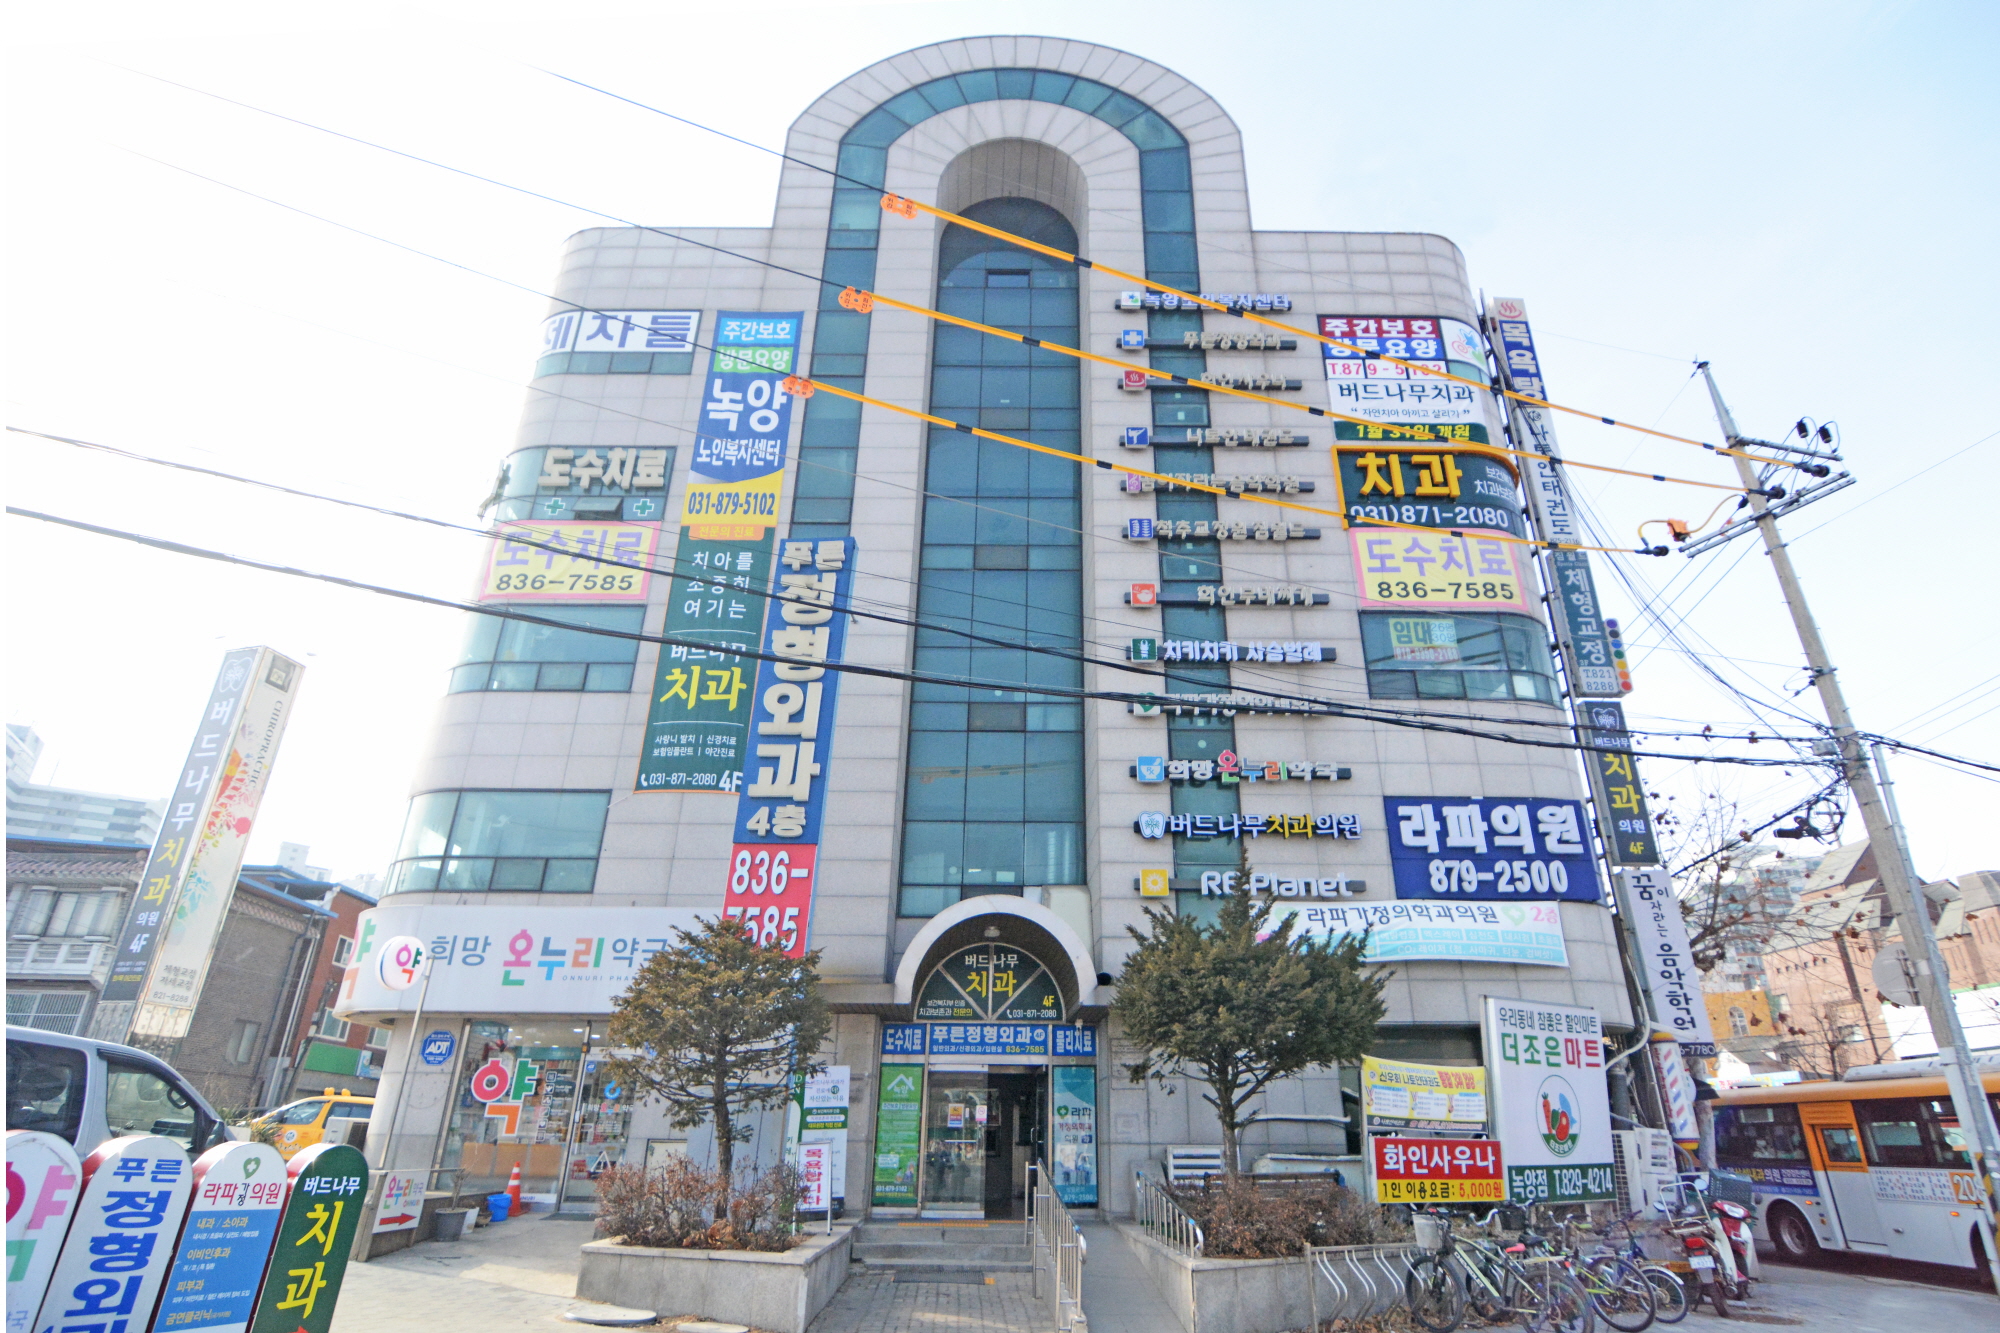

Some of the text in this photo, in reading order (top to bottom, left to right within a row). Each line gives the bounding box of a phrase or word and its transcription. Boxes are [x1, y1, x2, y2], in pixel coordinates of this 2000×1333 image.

[722, 320, 791, 342] 주간보호
[1324, 319, 1436, 339] 주간보호
[1328, 338, 1439, 357] 방문요양
[717, 350, 790, 373] 방문요양
[705, 377, 787, 432] 녹양
[1337, 382, 1476, 404] 버드나무치과
[1401, 407, 1430, 418] 아끼고
[1431, 408, 1460, 418] 살리기
[1356, 424, 1470, 442] 1월 31일 개원
[696, 438, 780, 467] 노인복지센터
[538, 447, 668, 490] 도수치료
[1356, 452, 1464, 498] 치과
[686, 490, 776, 517] 031-879-5102
[698, 526, 756, 538] 전문의 진료
[495, 528, 644, 571] 도수치료
[691, 551, 754, 571] 치아를
[780, 540, 846, 572] 푸른
[1365, 537, 1513, 578] 도수치료
[496, 574, 635, 592] 836-7585
[1377, 581, 1515, 600] 836-7585
[684, 598, 748, 618] 여기는
[1564, 568, 1607, 666] 체형교정
[1393, 621, 1433, 645] 임대
[1163, 639, 1322, 662] 치키치키 사슴벌레
[1583, 668, 1613, 679] T.821
[659, 665, 748, 712] 치과
[747, 572, 838, 802] 정형외과
[1586, 681, 1615, 692] 8288
[249, 700, 283, 788] CHIROPRACTIC
[654, 734, 738, 746] 사랑니 발치 신경치료
[1594, 736, 1630, 747] 버드나무
[704, 746, 737, 758] 야간진료
[170, 697, 235, 833] 버드나무
[1168, 749, 1339, 784] 희망 온누리 약국
[649, 770, 743, 793] 031-871-2080 4F
[1603, 752, 1642, 815] 치과
[746, 804, 807, 838] 4층
[1169, 812, 1364, 841] 버드나무치과의원
[1397, 803, 1585, 855] 라파의원
[1618, 819, 1646, 835] 의원
[1629, 841, 1645, 855] 4F
[142, 838, 185, 907] 치과
[731, 849, 809, 895] 836-
[1428, 858, 1569, 894] 879-2500
[135, 911, 160, 927] 의원
[1306, 904, 1558, 927] 라파가정의학과의원 2층
[129, 933, 150, 953] 4F
[1423, 930, 1462, 941] 엑스레이
[429, 935, 492, 967] 희망
[502, 929, 605, 986] 온누리
[1418, 944, 1447, 954] 레이저
[395, 943, 424, 984] 약
[964, 953, 1020, 969] 버드나무
[965, 970, 1018, 999] 치과
[152, 990, 190, 1003] 821-8288
[1042, 995, 1055, 1008] 4F
[918, 1007, 973, 1017] 치과보존과 전문의
[1012, 1009, 1057, 1019] 031-871-2080
[1499, 1007, 1599, 1035] 우리동네 참좋은 할인마트
[885, 1028, 923, 1051] 도수치료
[933, 1025, 1032, 1044] 푸른정형외과
[1056, 1030, 1093, 1054] 물리치료
[425, 1041, 450, 1055] ADT
[1005, 1044, 1045, 1054] 836-7585
[471, 1057, 539, 1136] 약
[1070, 1107, 1093, 1119] 라파
[112, 1157, 184, 1184] 푸른
[1383, 1143, 1496, 1175] 화인사우나
[303, 1175, 361, 1196] 버드나무
[383, 1175, 414, 1210] 온누리
[1382, 1182, 1402, 1199] 1인
[1459, 1181, 1503, 1199] 5,000원
[1511, 1166, 1614, 1199] 녹양점 T.829-4214
[196, 1216, 249, 1229] 내과 소아과
[186, 1246, 232, 1260] 이비인후과
[276, 1201, 345, 1320] 치과
[176, 1279, 205, 1293] 피부과
[165, 1309, 213, 1327] 금연클리닉
